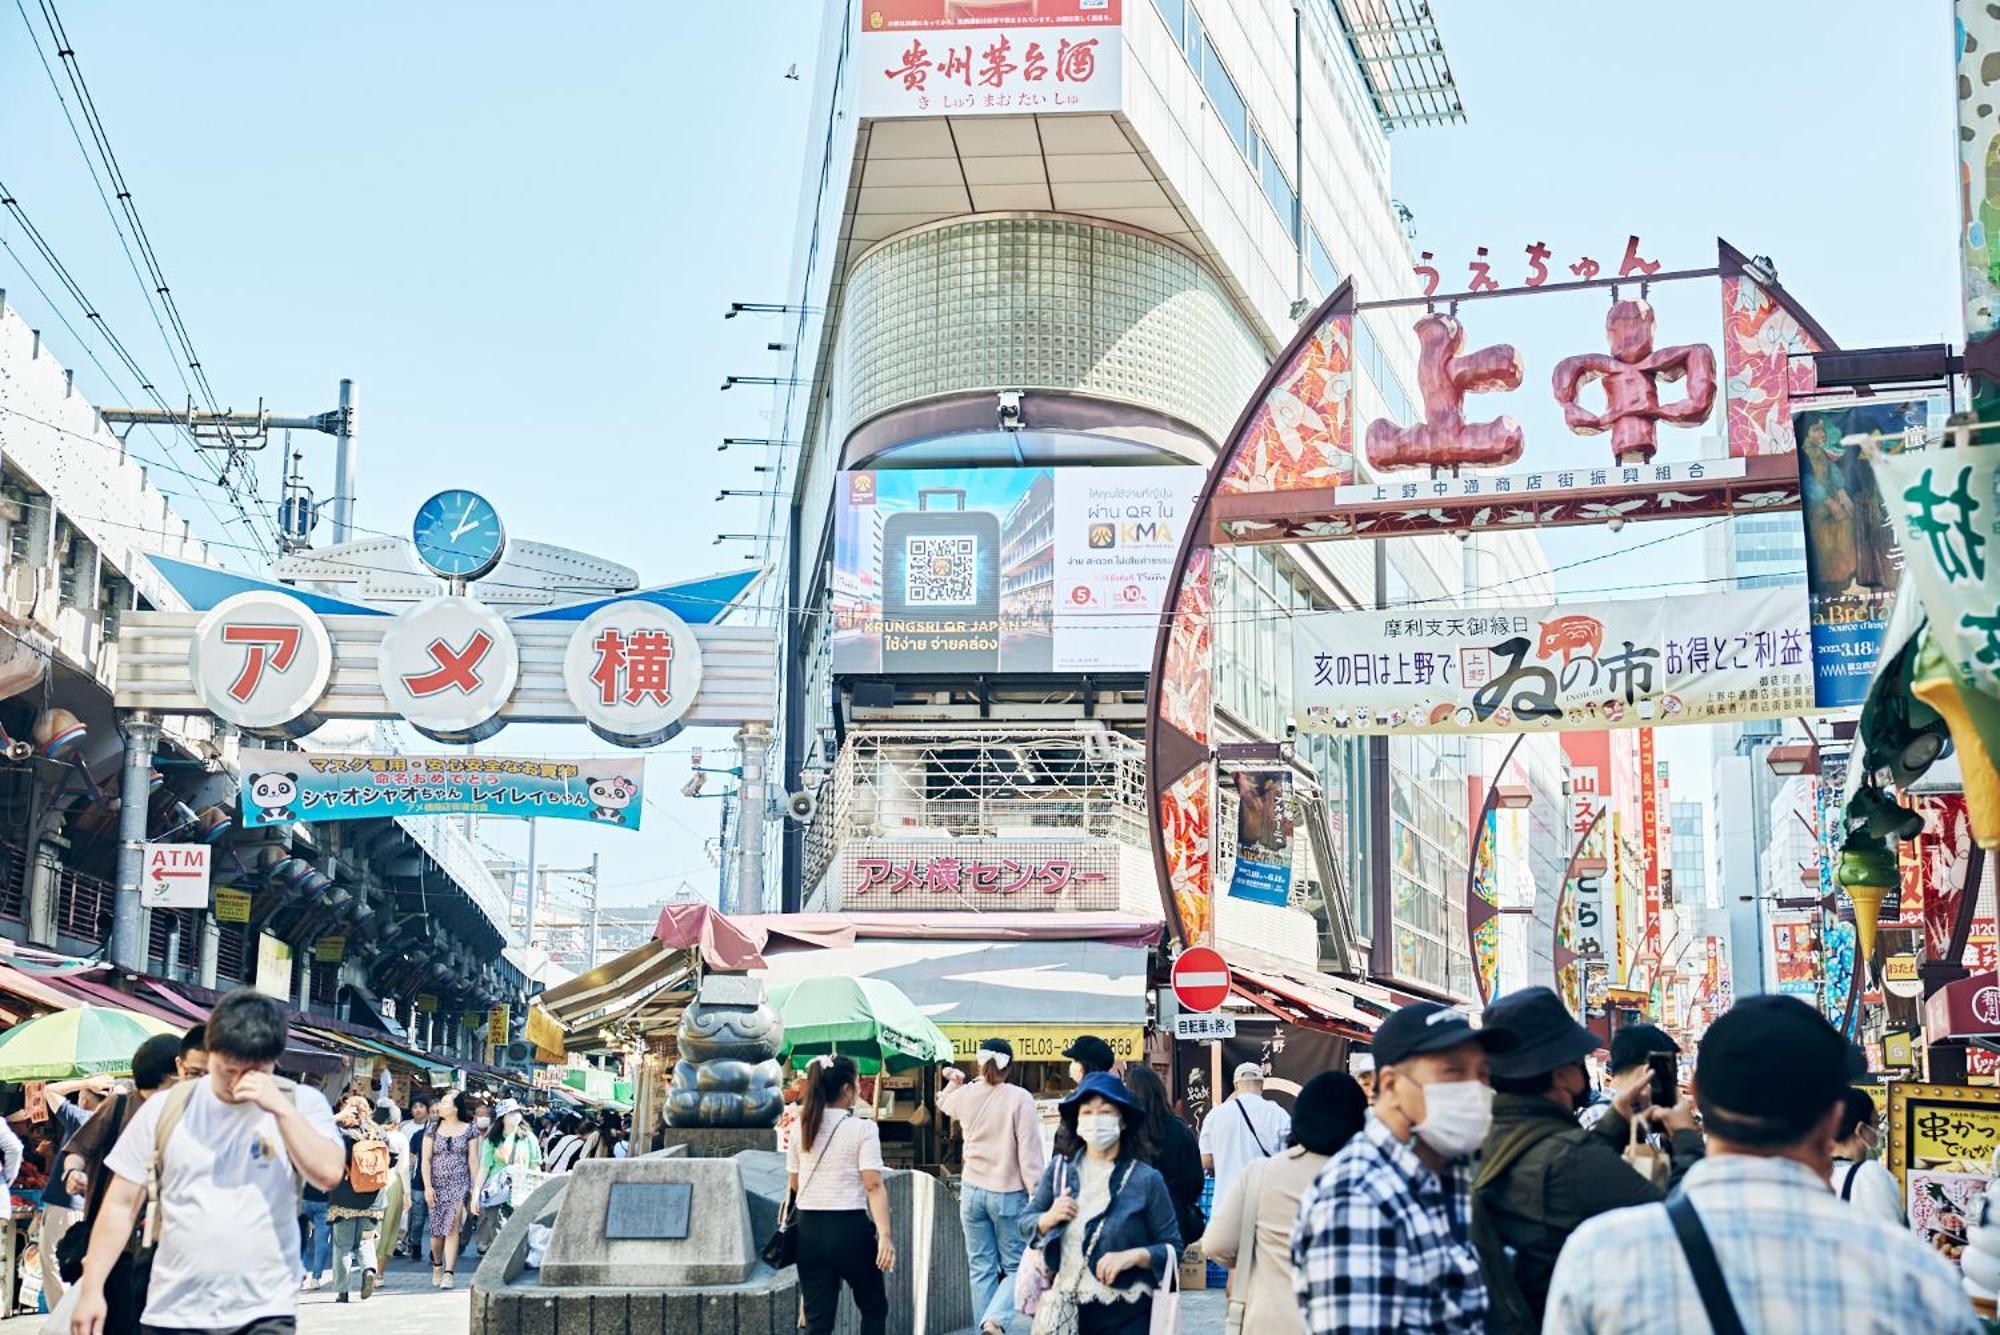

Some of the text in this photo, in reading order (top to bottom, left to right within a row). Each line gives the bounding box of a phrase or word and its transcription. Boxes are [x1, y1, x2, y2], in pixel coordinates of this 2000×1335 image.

[885, 33, 1099, 91] 貴州茅台酒
[1413, 235, 1660, 297] うえちゅん
[1366, 300, 1717, 472] 上中
[1372, 462, 1705, 501] 上野中通商店街振興組合
[1126, 506, 1152, 519] QR
[1121, 522, 1174, 542] KMA
[1384, 616, 1528, 638] 摩利支天御縁日
[222, 622, 674, 706] アメ横
[1666, 629, 1813, 675] お得とご利益
[1314, 652, 1456, 686] 亥の日は上野で
[375, 772, 499, 786] 命名おめでとう
[302, 786, 589, 808] シャオシャオちゃん レイレイちゃん
[151, 850, 204, 867] ATM
[856, 858, 1107, 894] アメ横センター
[1178, 1018, 1232, 1035] 自転車を除く
[1918, 1111, 1996, 1142] 串かつ
[1940, 1139, 1995, 1159] でんが
